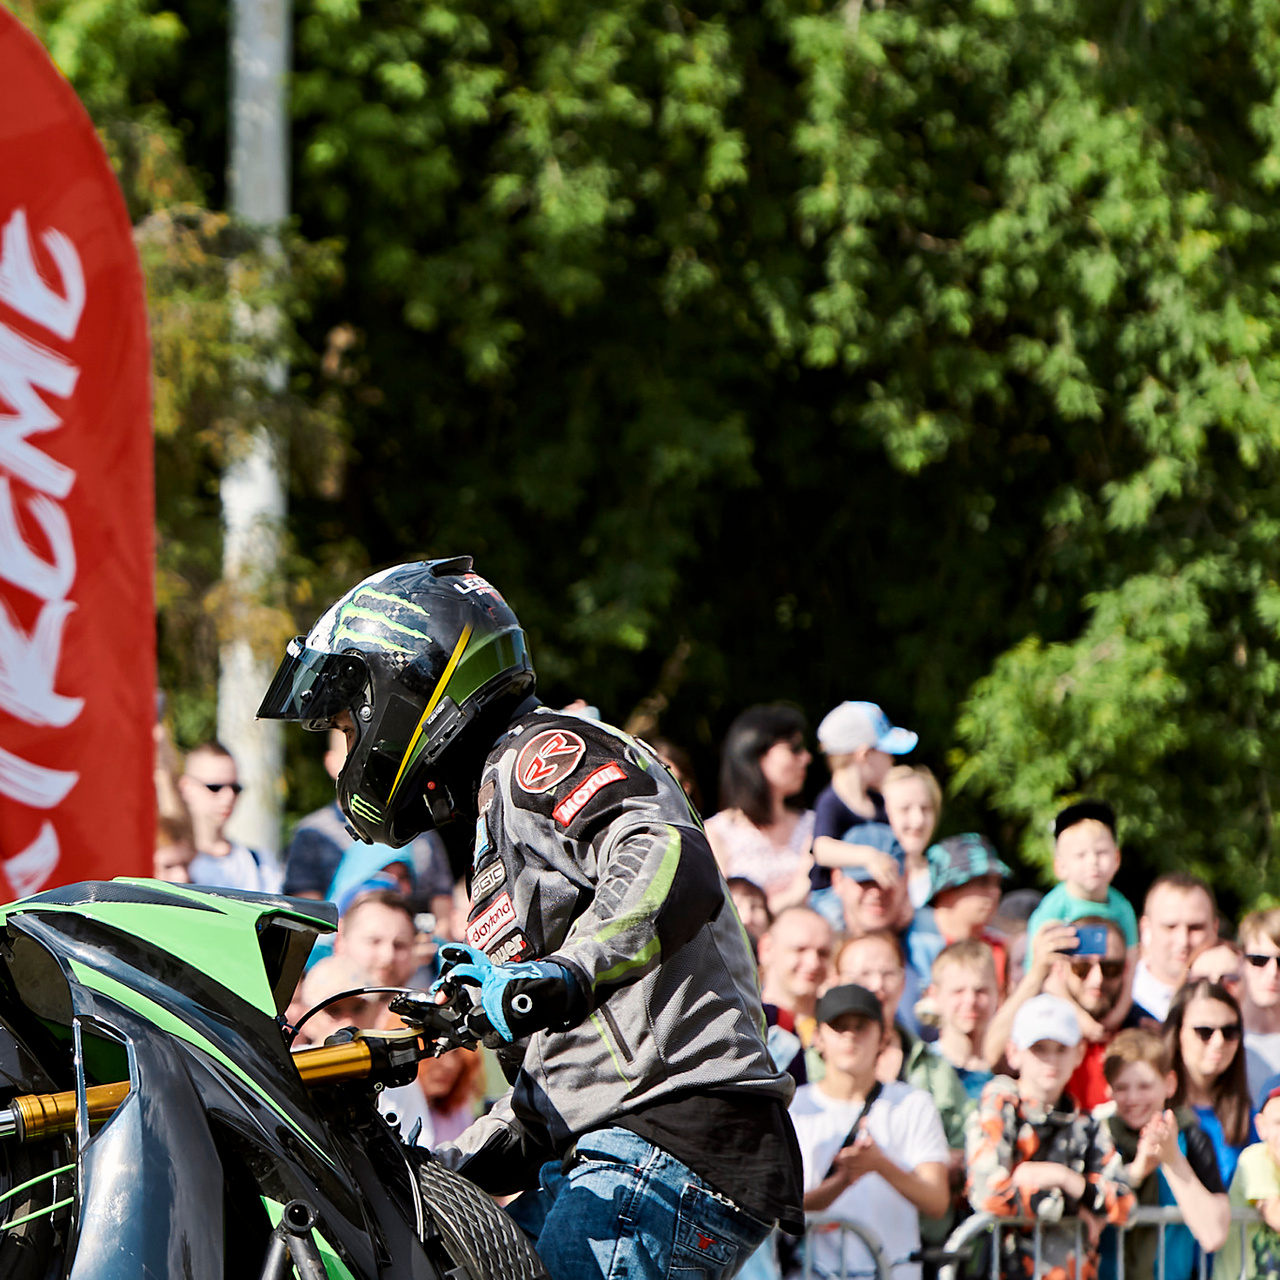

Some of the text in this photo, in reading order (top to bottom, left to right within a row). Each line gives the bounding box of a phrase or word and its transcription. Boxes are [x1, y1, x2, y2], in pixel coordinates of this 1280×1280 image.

[453, 577, 493, 595] LEG
[558, 765, 622, 823] MOTUL
[472, 901, 511, 943] daytona
